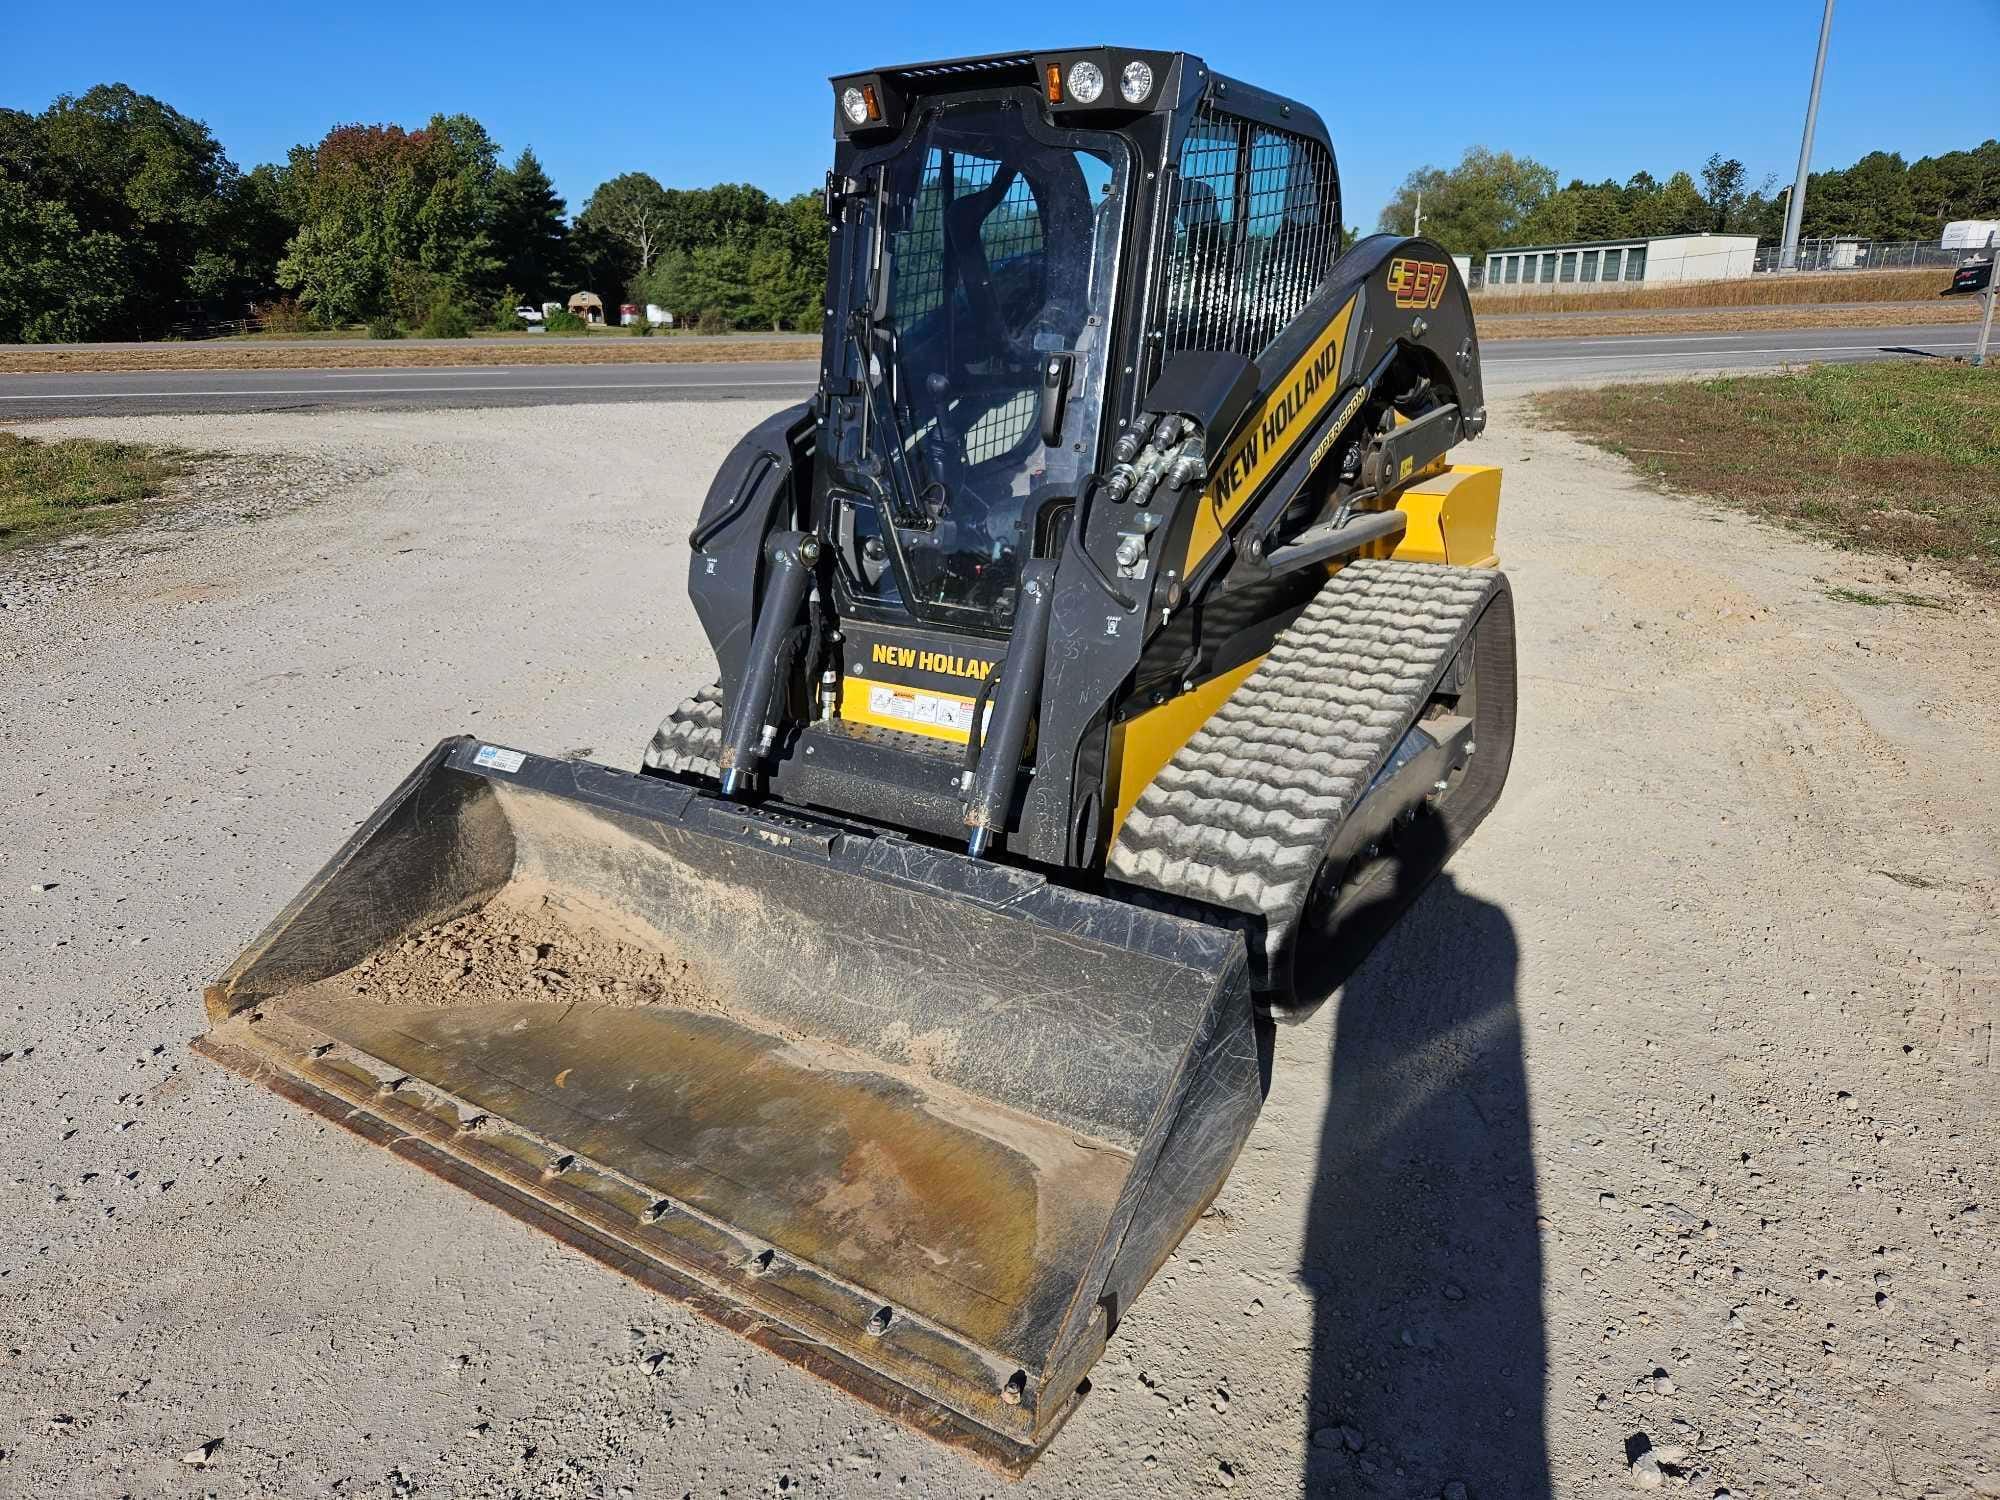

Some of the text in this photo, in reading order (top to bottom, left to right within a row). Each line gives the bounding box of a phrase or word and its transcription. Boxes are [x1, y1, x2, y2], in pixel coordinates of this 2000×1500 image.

[1214, 340, 1336, 509] NEW HOLLAND
[1309, 386, 1367, 470] SUPER BOOM
[872, 643, 1000, 682] NEW HOLLAN
